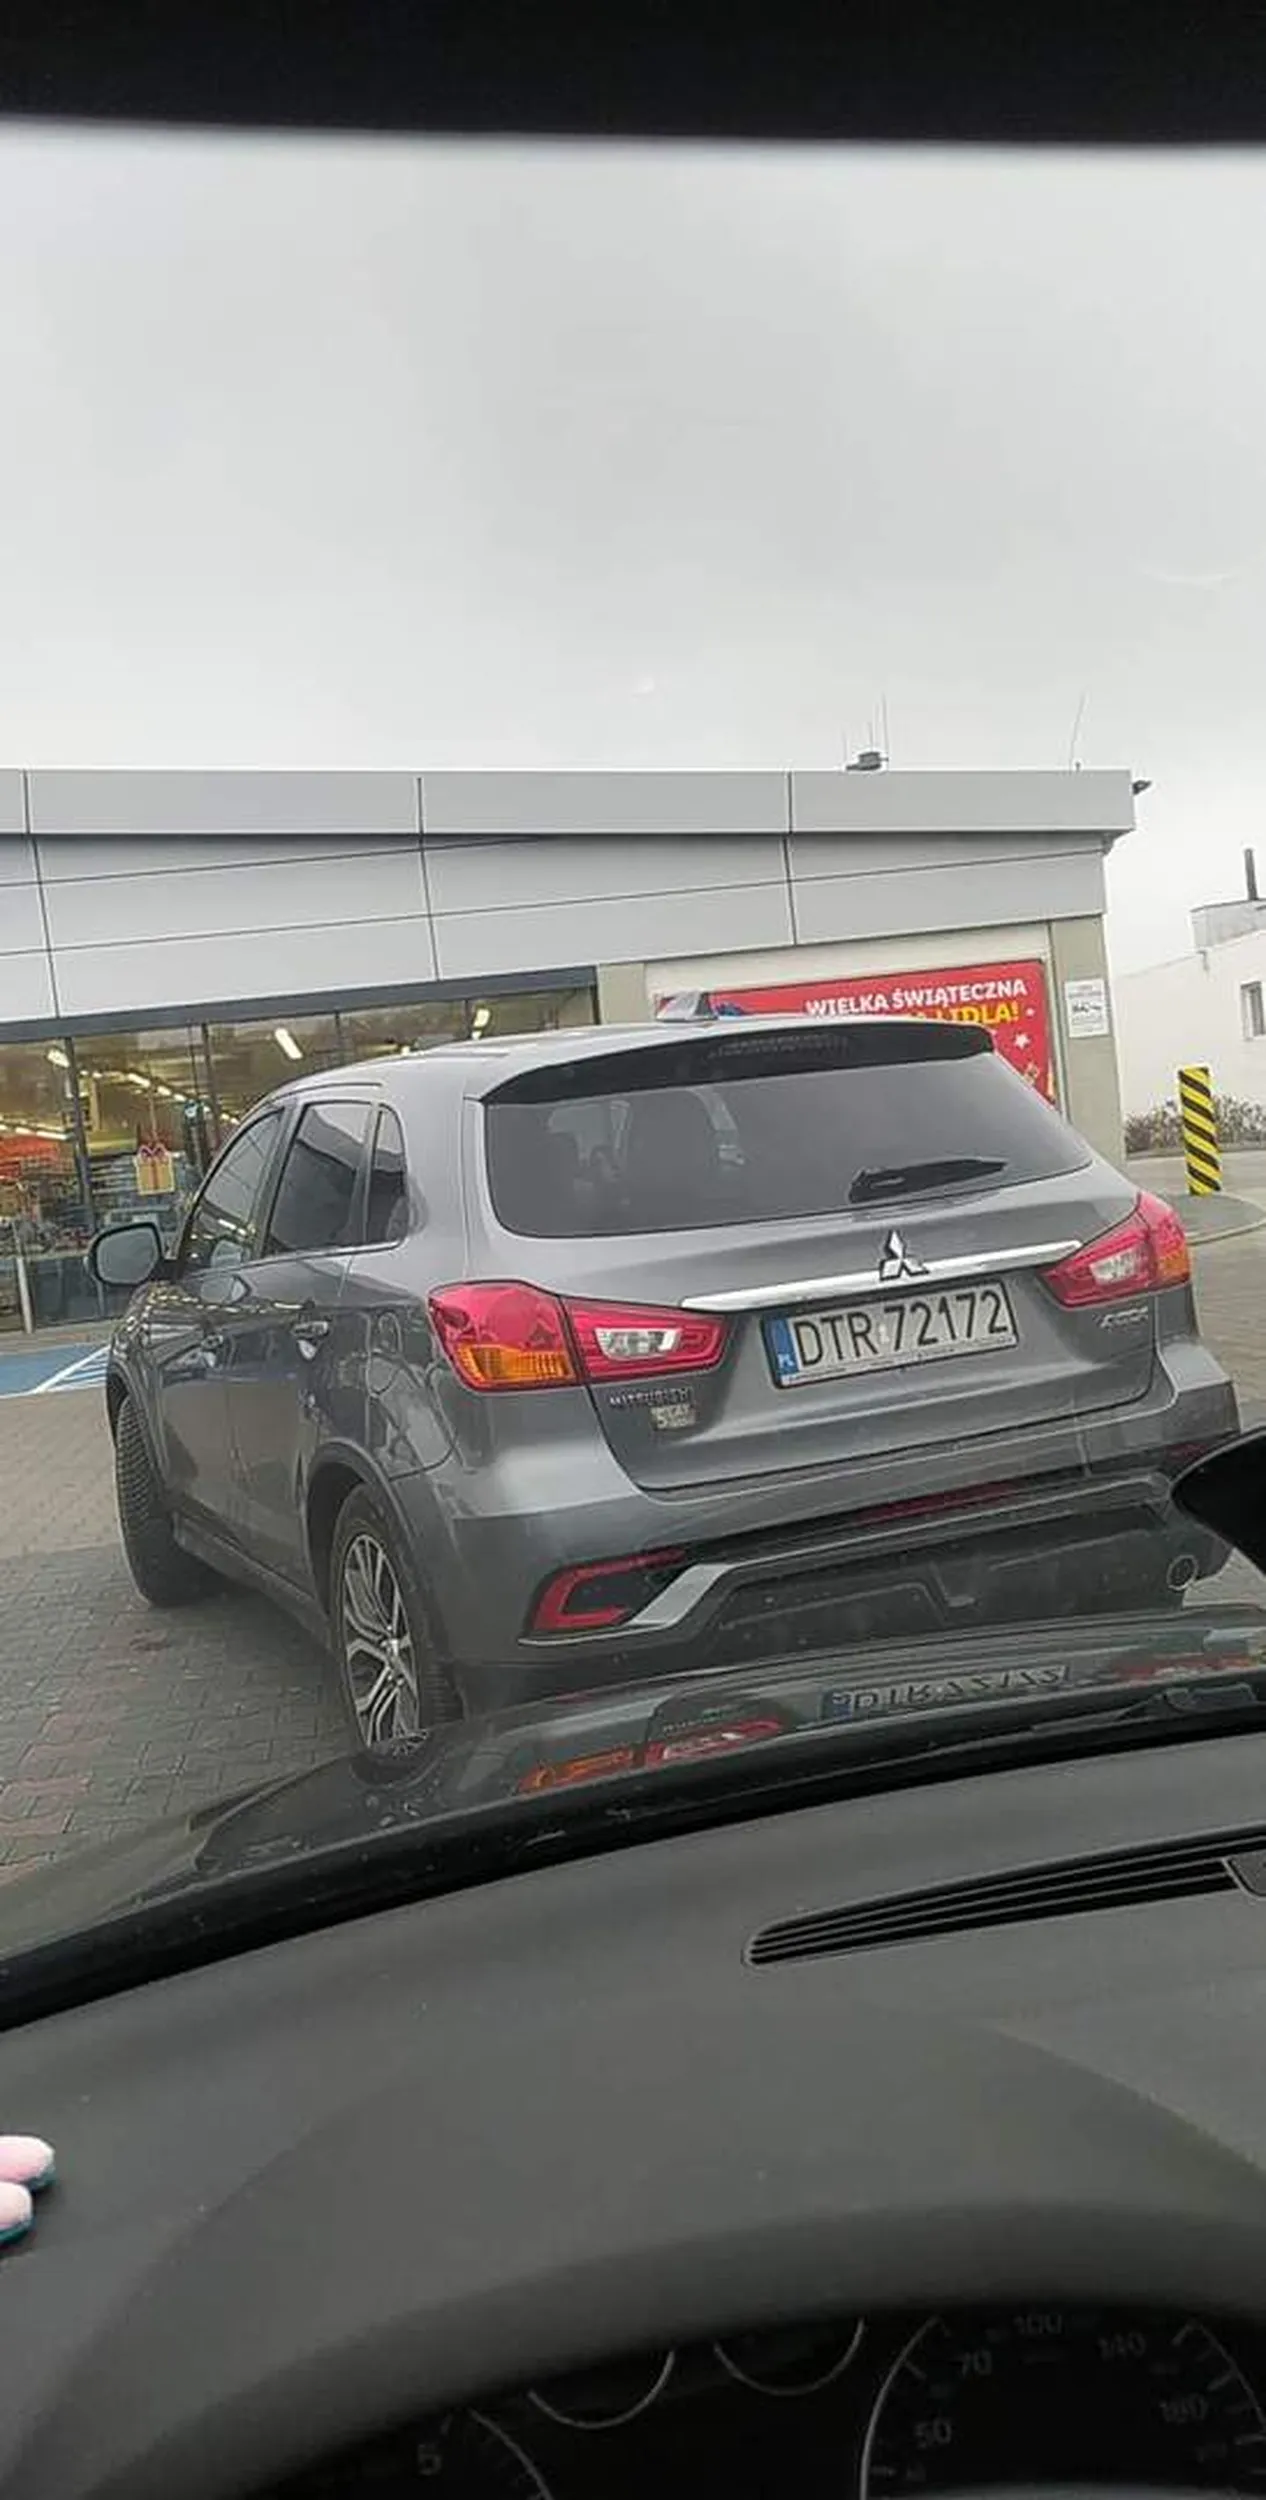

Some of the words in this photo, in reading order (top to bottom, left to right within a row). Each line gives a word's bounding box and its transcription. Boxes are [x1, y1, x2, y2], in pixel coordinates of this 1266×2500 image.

[805, 993, 890, 1016] WIELKA
[891, 979, 1028, 1008] ŚWIĄTECZNA
[793, 1311, 878, 1367] DTR
[884, 1289, 1008, 1351] 72172
[1012, 2311, 1063, 2336] 100
[959, 2348, 993, 2378] 70
[914, 2416, 953, 2450] 50
[418, 2444, 443, 2476] 5
